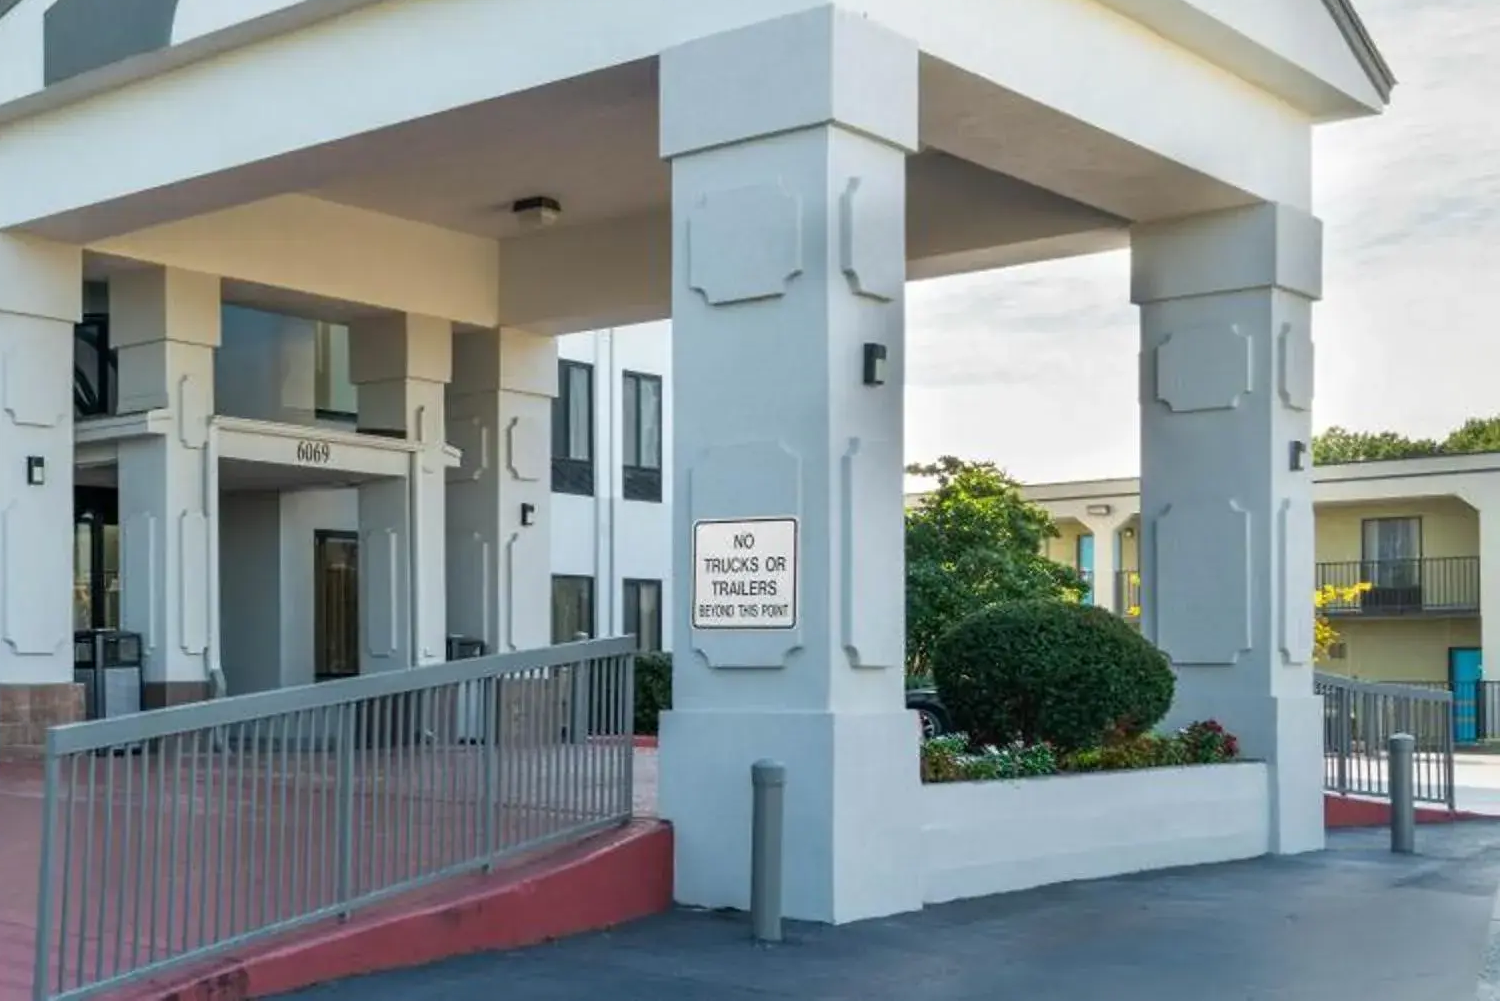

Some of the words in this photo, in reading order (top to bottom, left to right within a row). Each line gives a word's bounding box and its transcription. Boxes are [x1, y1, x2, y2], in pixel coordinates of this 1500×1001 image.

[297, 440, 330, 463] 6069
[733, 533, 755, 549] NO
[704, 556, 760, 574] TRUCKS
[765, 556, 787, 572] OR
[711, 580, 777, 596] TRAILERS
[699, 604, 735, 618] BEYOND
[738, 604, 758, 618] THIS
[761, 604, 788, 618] POINT
